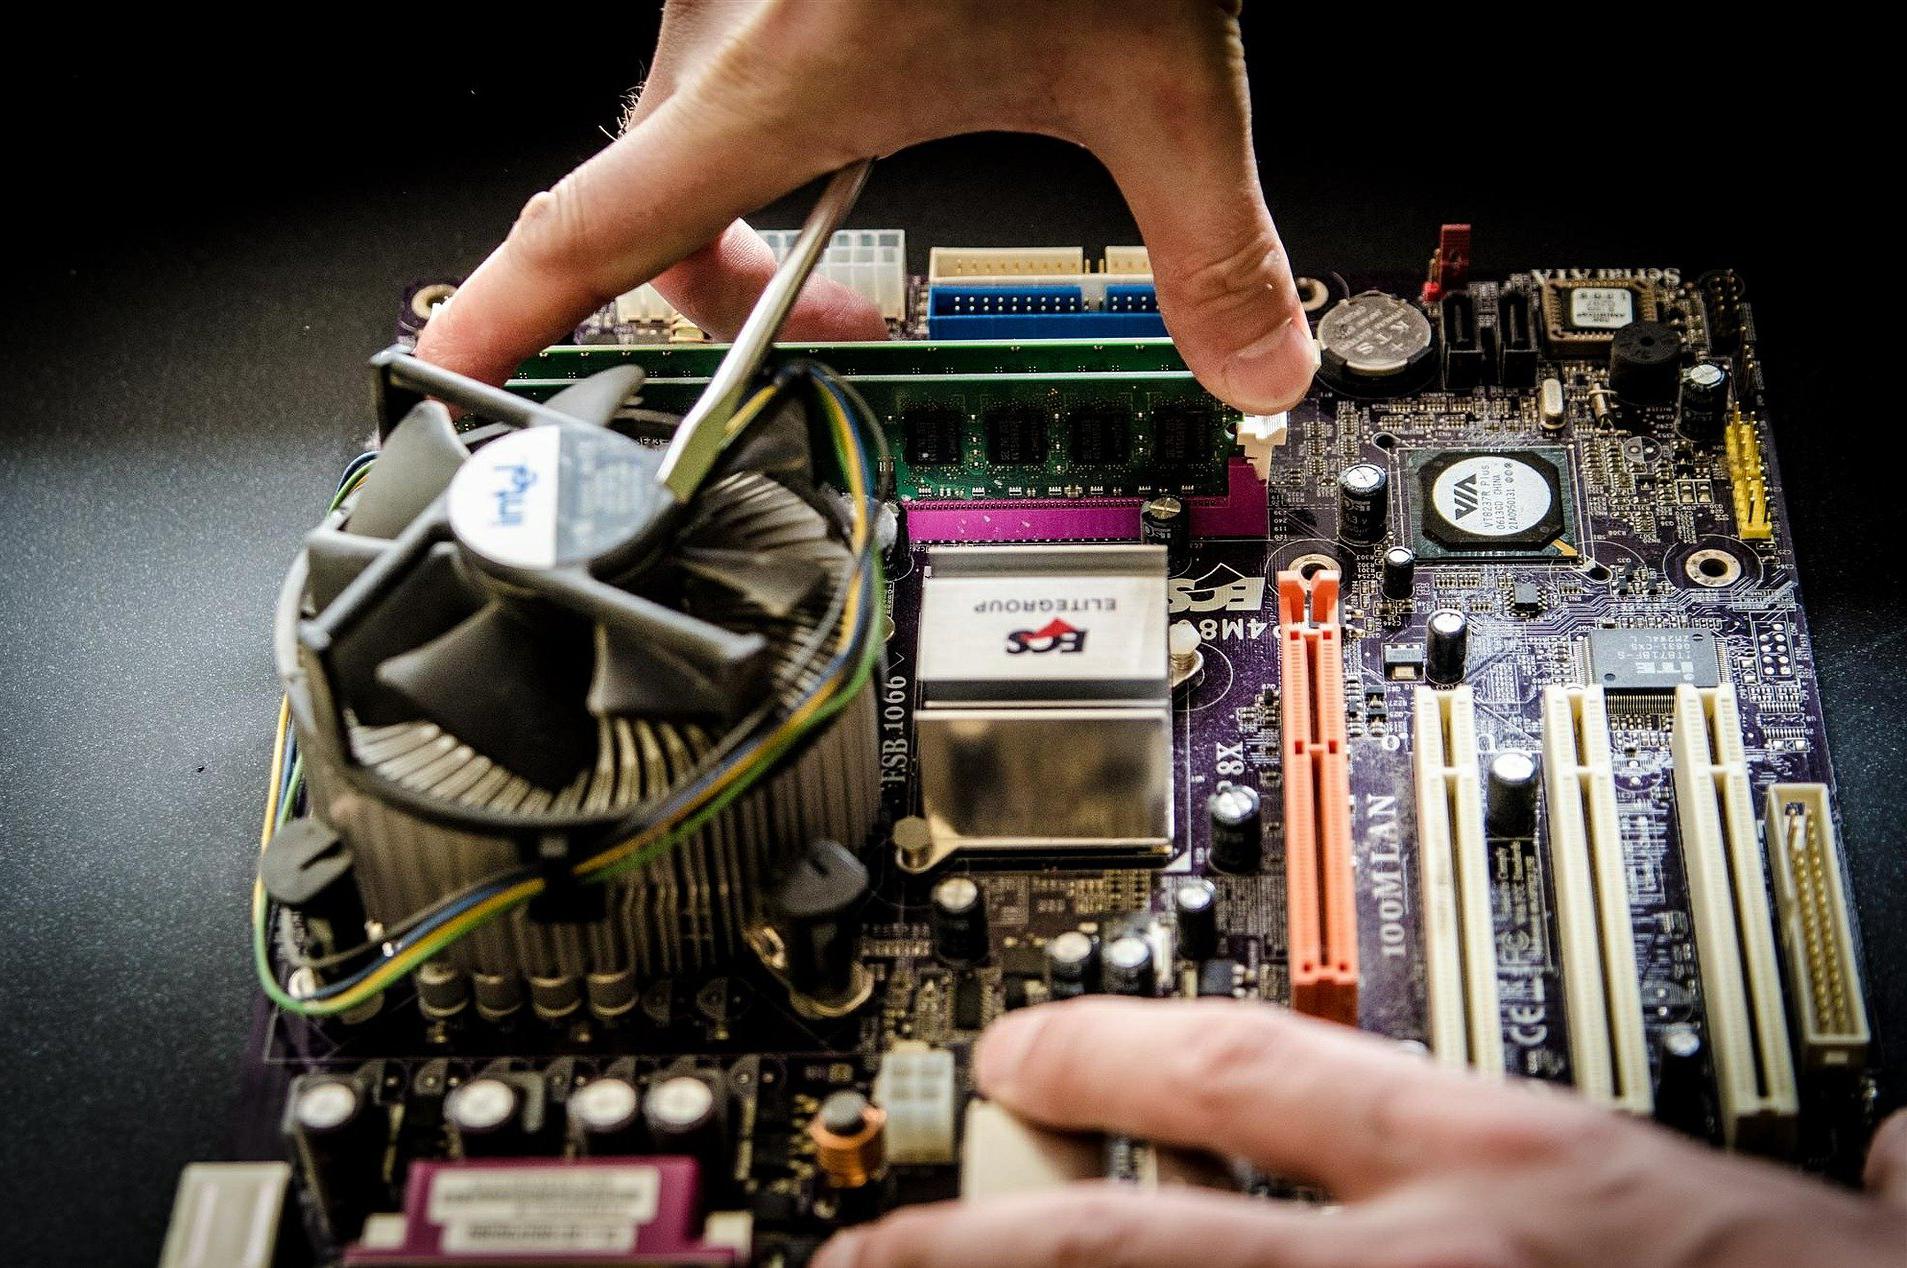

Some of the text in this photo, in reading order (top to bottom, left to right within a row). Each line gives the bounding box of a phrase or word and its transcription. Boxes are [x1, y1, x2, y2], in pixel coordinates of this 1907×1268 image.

[1479, 464, 1491, 487] Plus
[1493, 474, 1503, 496] CHINA
[1453, 473, 1479, 521] VIA
[973, 597, 1117, 614] ELITEGROUP
[1167, 577, 1266, 614] ECS
[1005, 628, 1088, 656] ECS
[881, 676, 909, 783] FSB 1066
[1215, 741, 1246, 776] 8X
